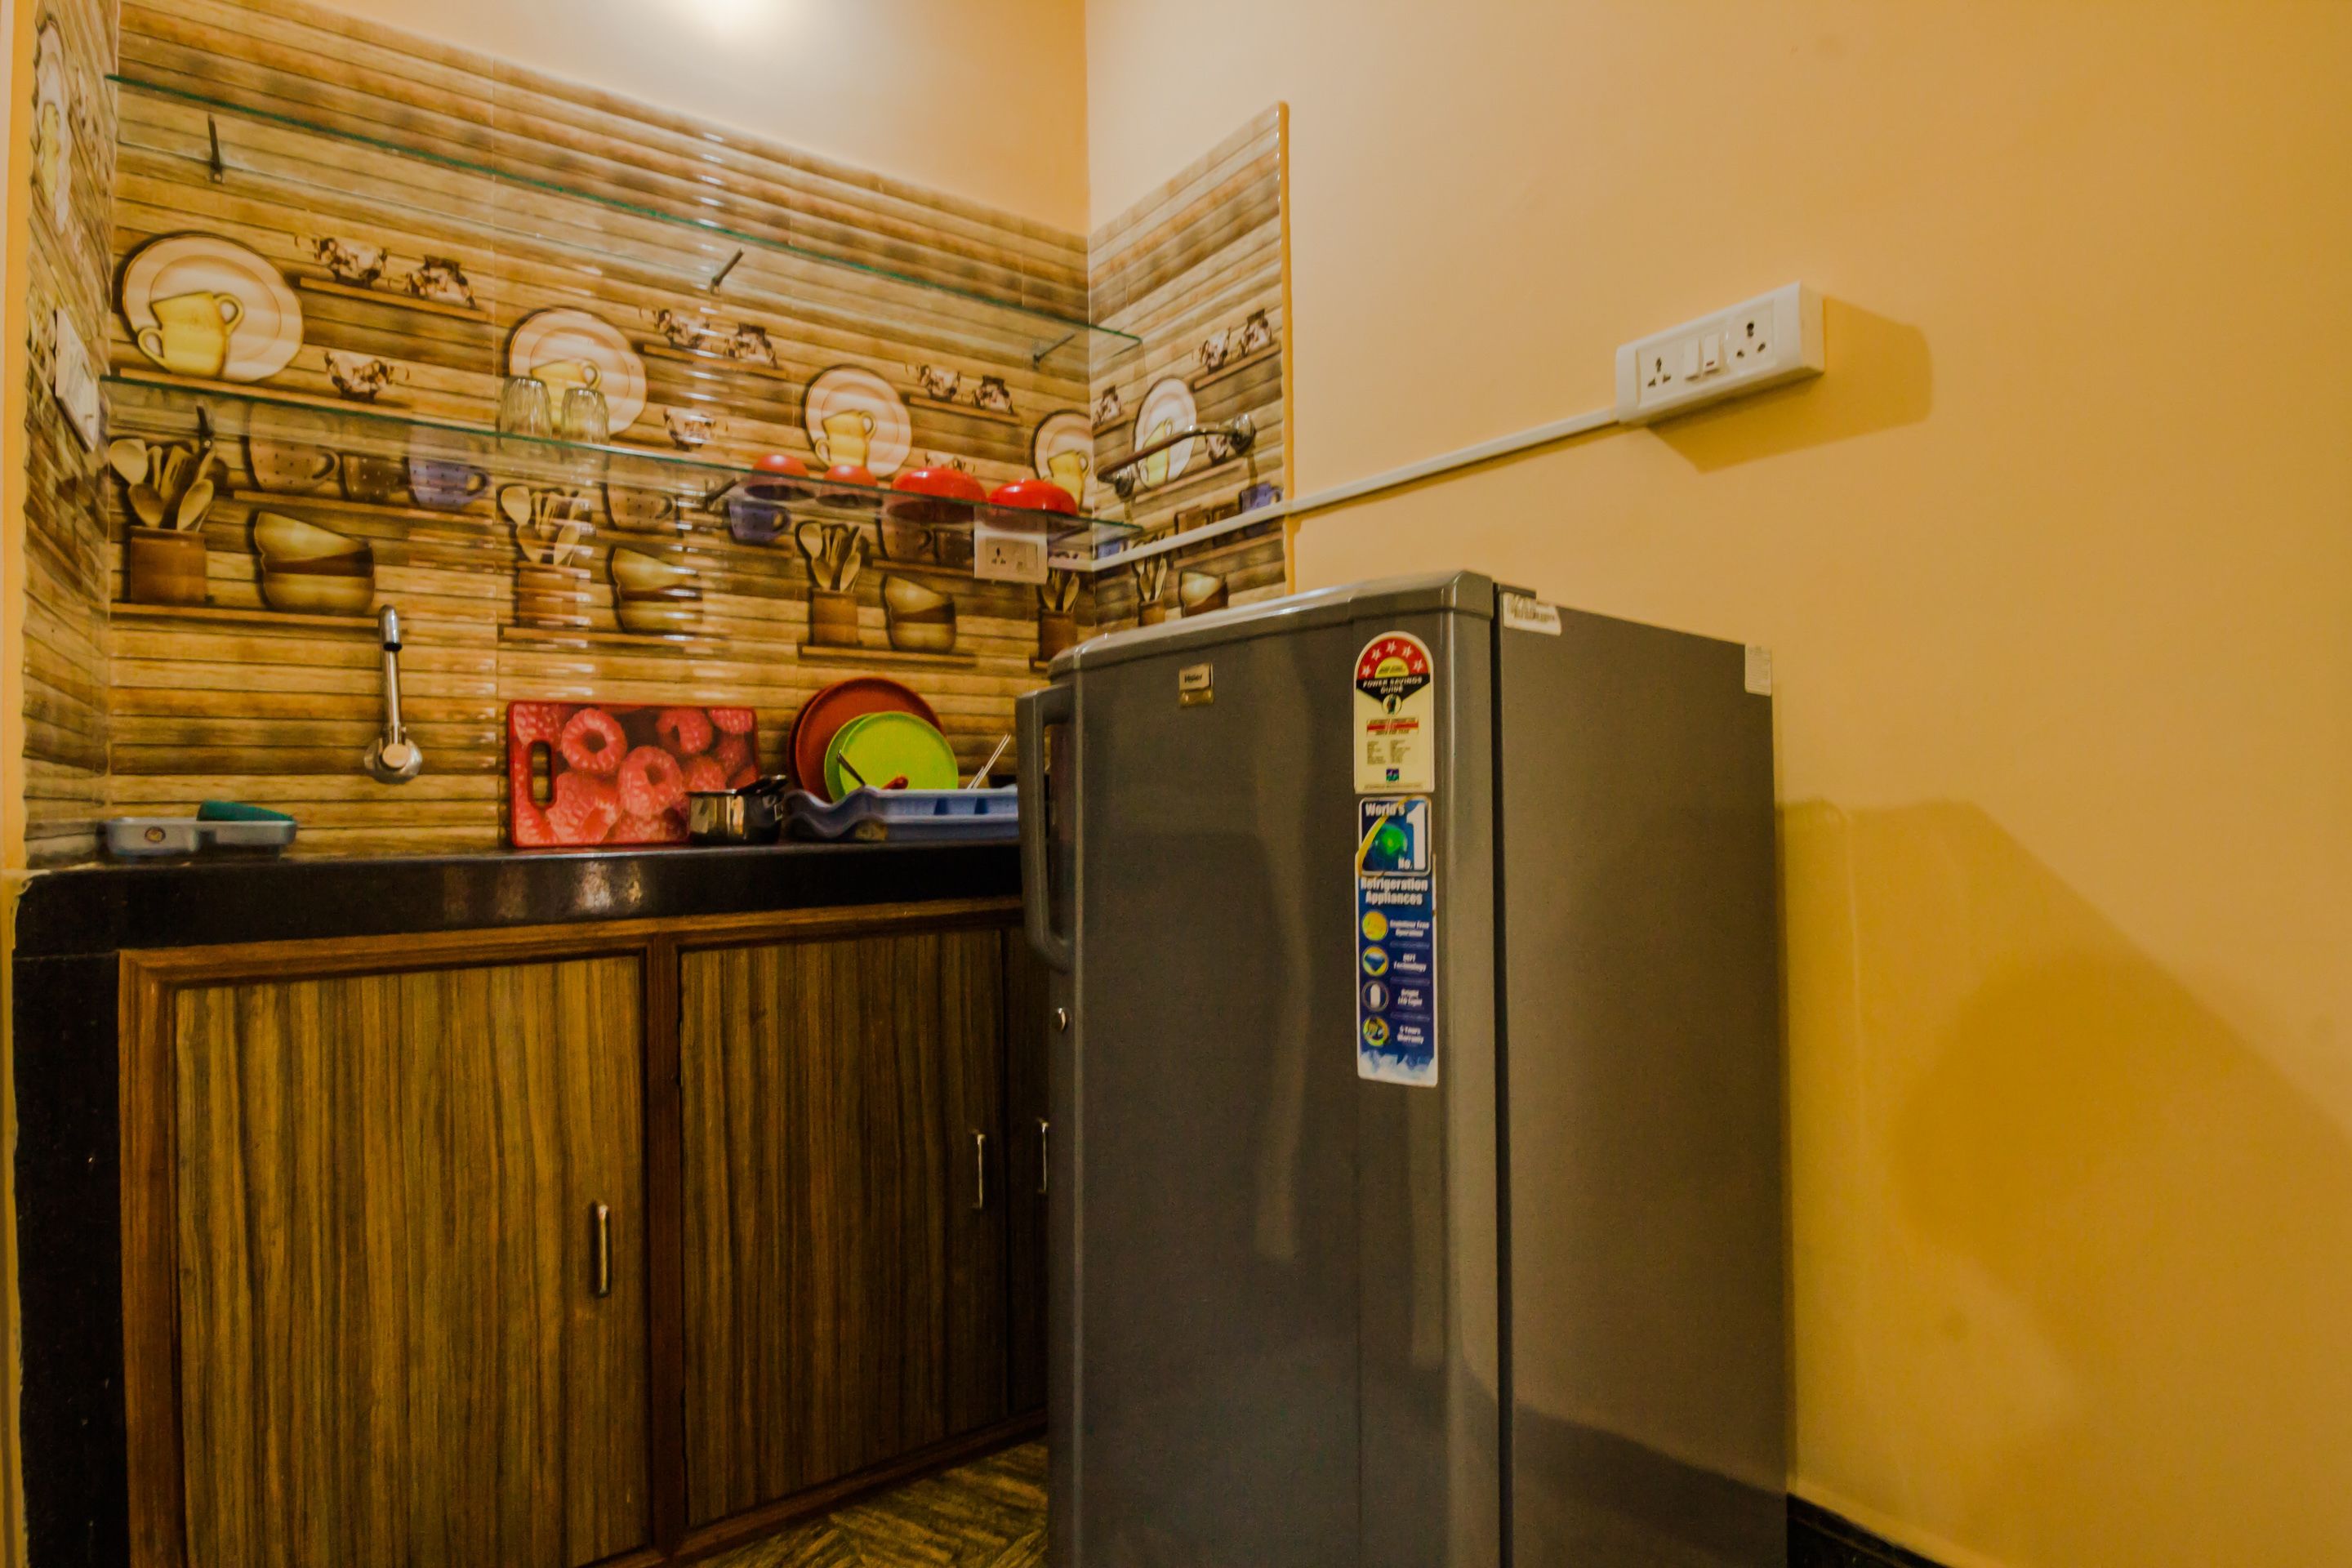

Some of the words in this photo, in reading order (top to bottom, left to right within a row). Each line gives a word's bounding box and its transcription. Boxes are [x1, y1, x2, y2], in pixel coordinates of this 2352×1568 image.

[1365, 803, 1405, 817] World's
[1405, 802, 1426, 871] 1
[1361, 876, 1428, 892] Refrigeration
[1365, 891, 1423, 906] Appliances
